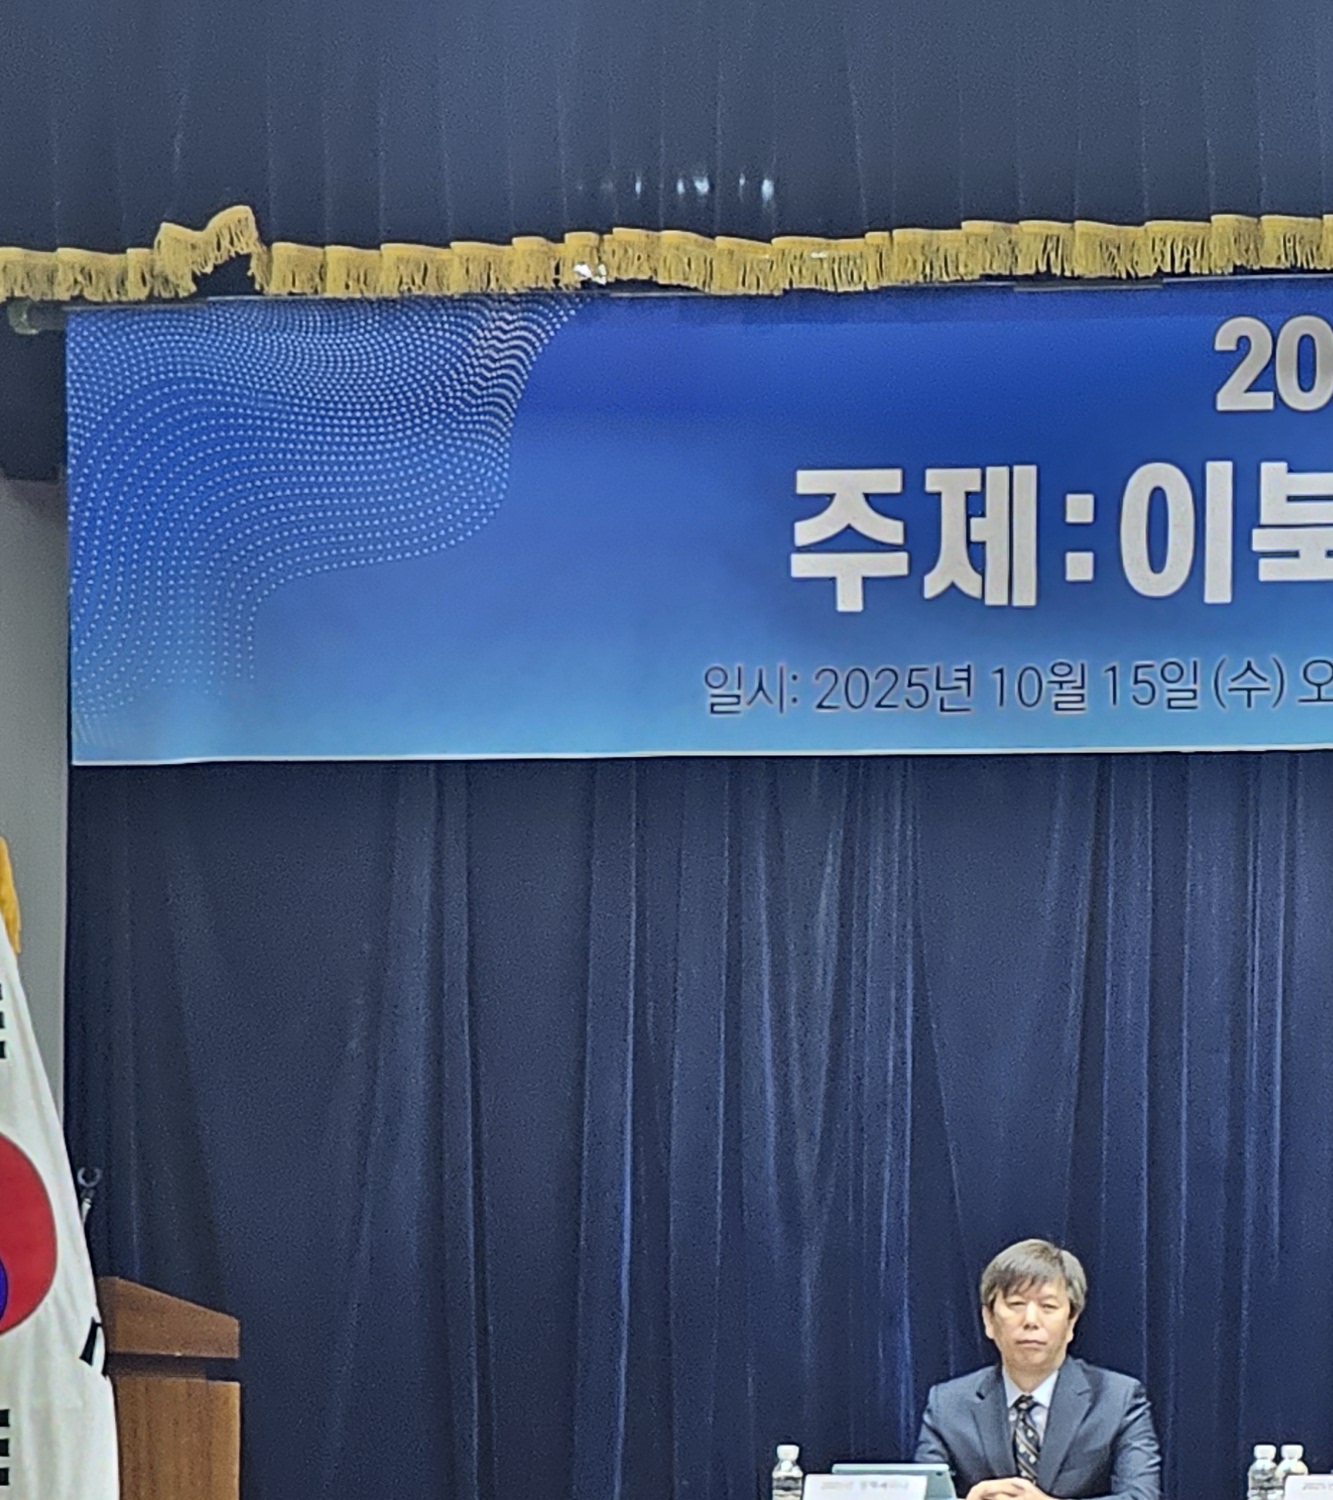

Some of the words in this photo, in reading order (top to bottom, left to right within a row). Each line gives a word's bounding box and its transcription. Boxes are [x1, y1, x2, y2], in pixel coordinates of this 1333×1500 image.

[703, 664, 798, 715] 일시:
[813, 662, 974, 715] 2025년
[992, 659, 1087, 713] 10월
